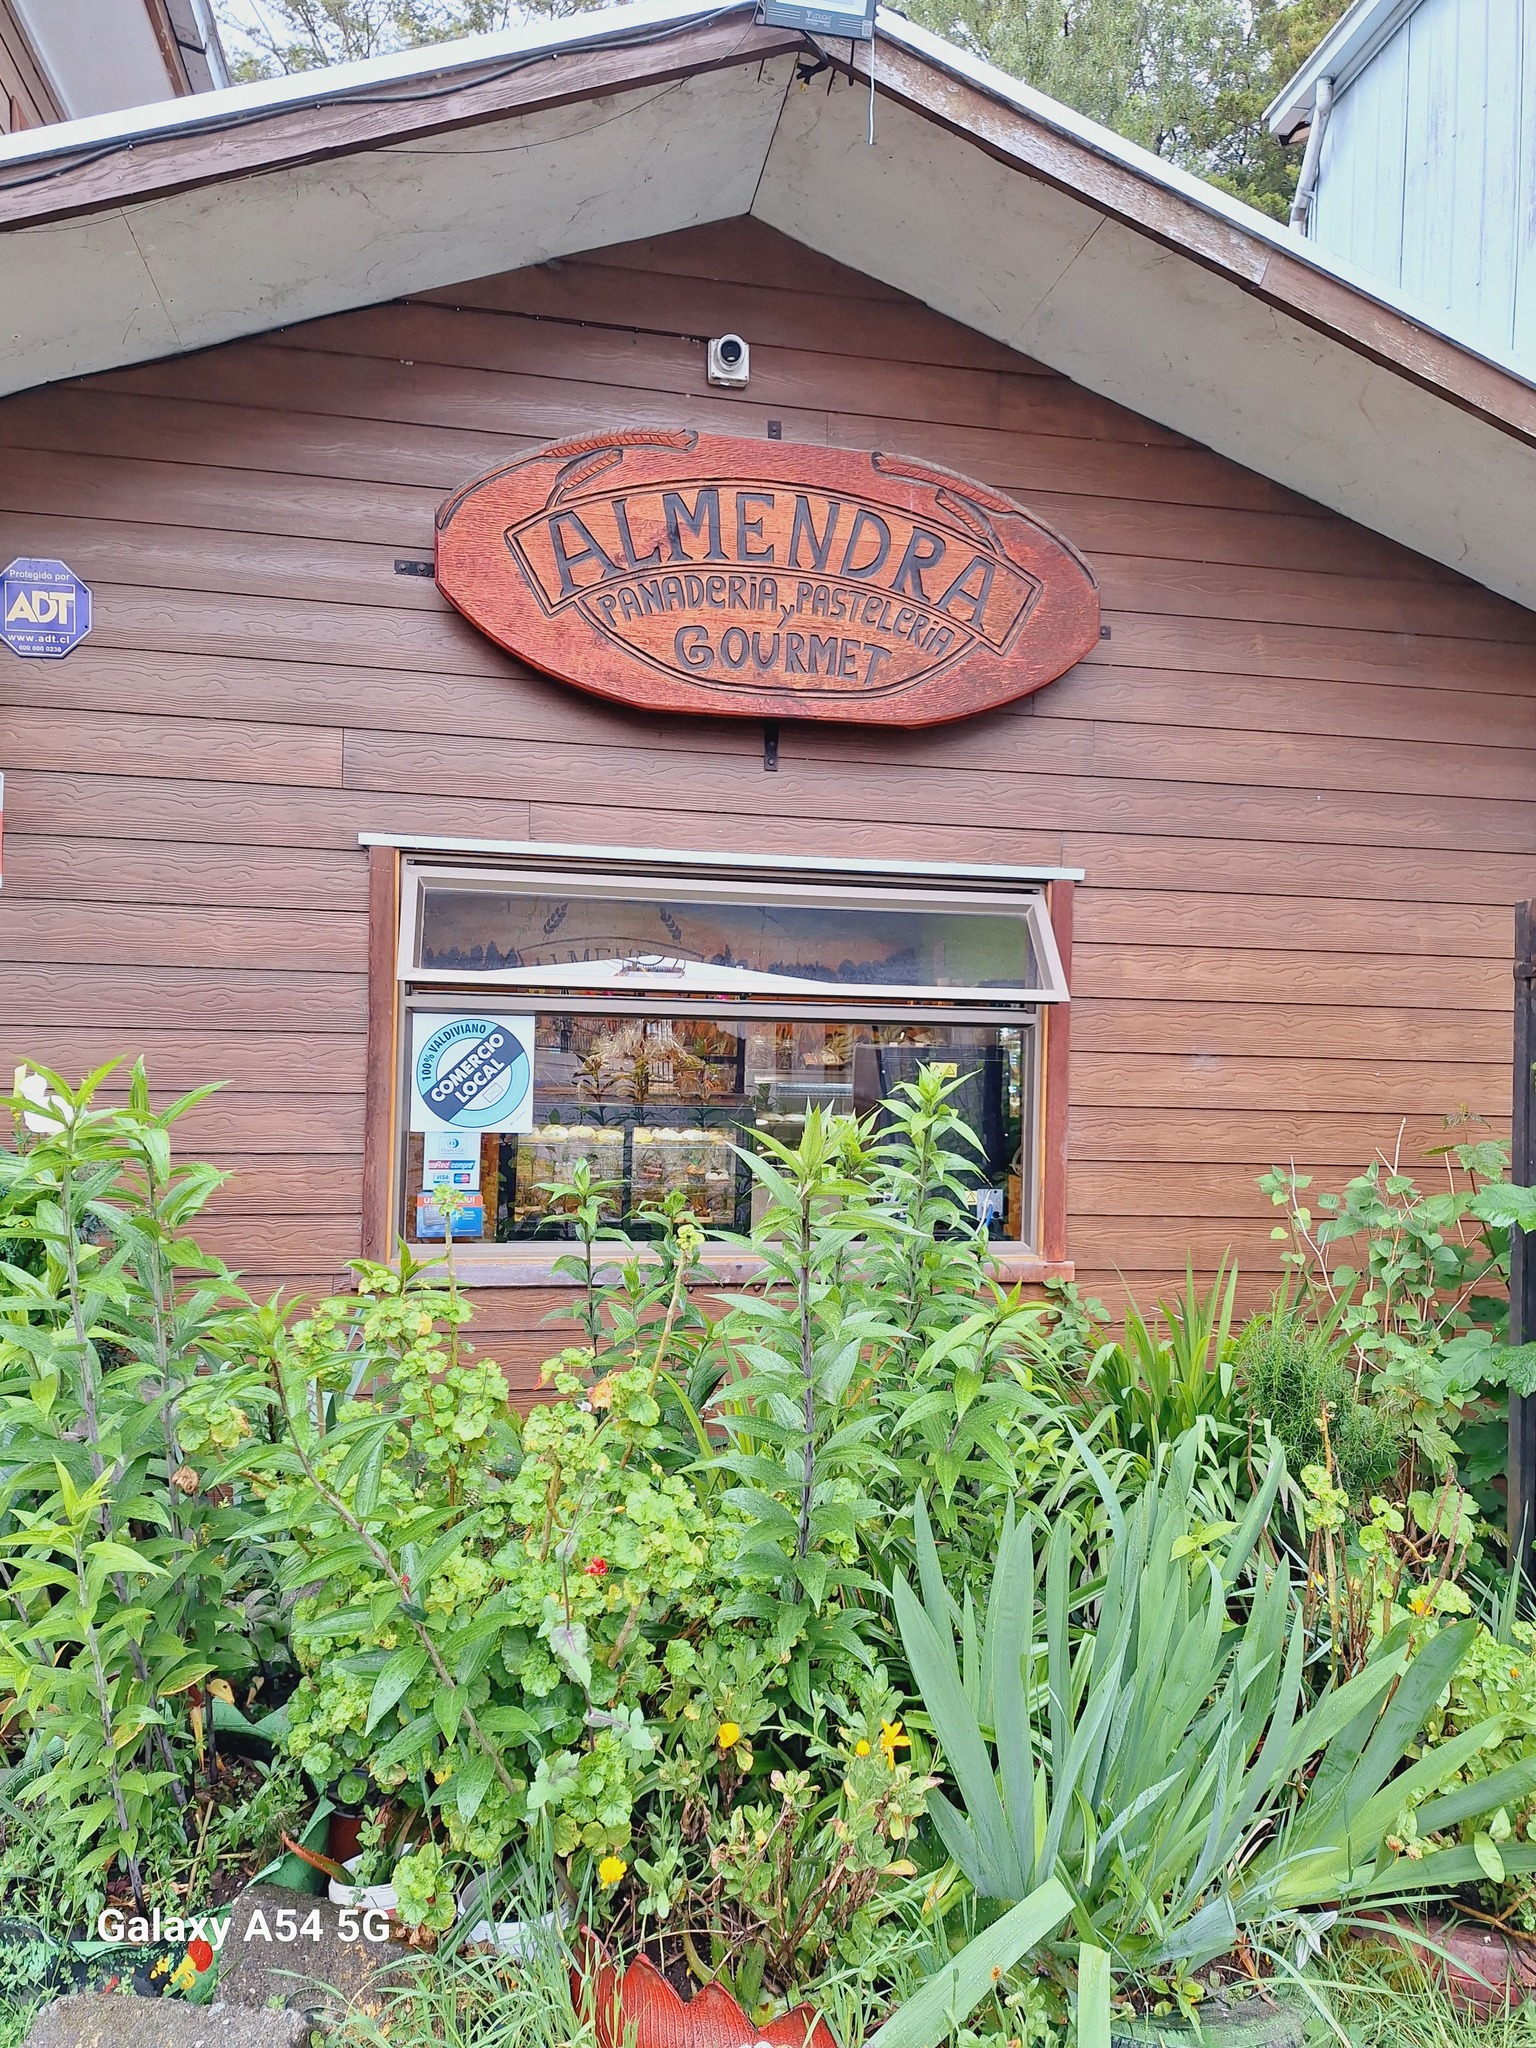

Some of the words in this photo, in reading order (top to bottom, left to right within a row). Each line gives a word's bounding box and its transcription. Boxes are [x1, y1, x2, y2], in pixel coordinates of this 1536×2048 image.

[9, 569, 53, 581] Protegido
[55, 573, 70, 582] por
[547, 489, 997, 632] ALMENDRA
[6, 590, 74, 625] ADT
[8, 634, 70, 644] www.adt.cl
[674, 625, 893, 686] GOURMET
[428, 1023, 487, 1053] VALDIVIANO
[422, 1054, 435, 1081] 100%
[431, 1033, 505, 1102] COMERCIO
[454, 1058, 505, 1103] LOCAL
